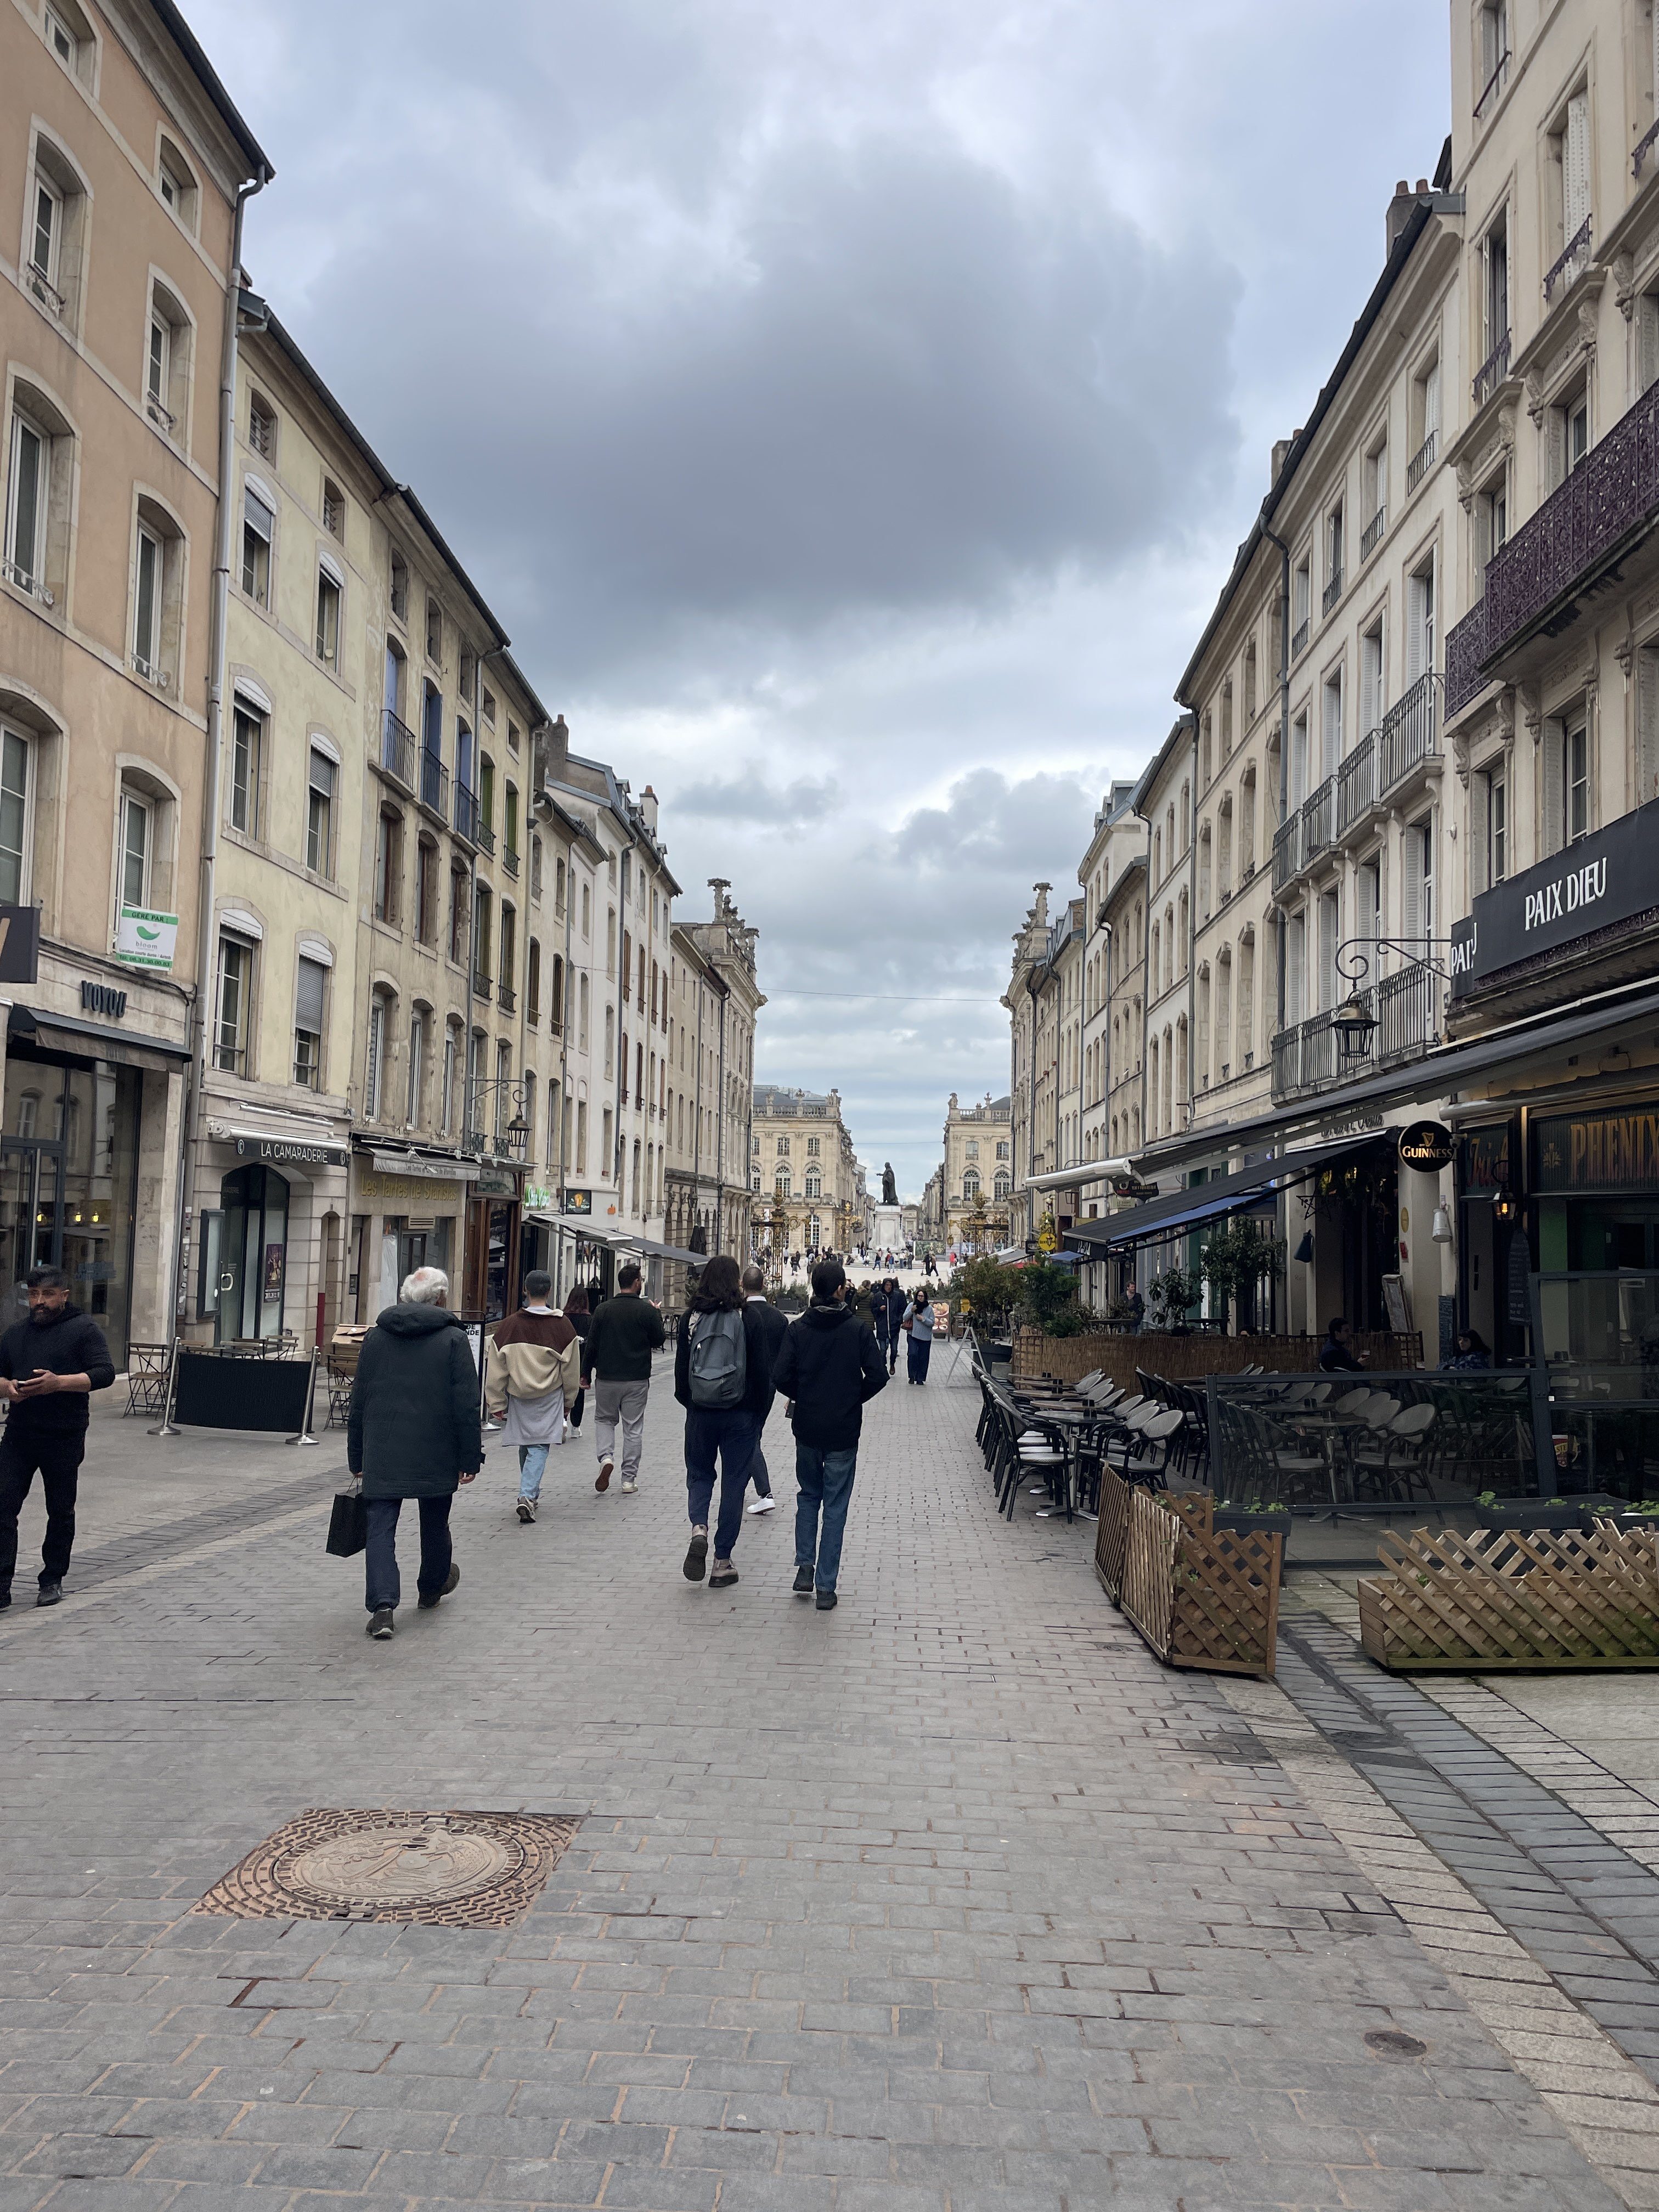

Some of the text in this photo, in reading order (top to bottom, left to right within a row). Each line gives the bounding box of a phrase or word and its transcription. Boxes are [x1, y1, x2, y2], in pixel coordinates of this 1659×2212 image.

[1525, 857, 1607, 931] PAIX DIEU
[132, 912, 149, 920] GÉRÉ
[136, 941, 158, 950] bloom
[81, 980, 128, 1018] VOYOU
[261, 1142, 272, 1158] LA
[274, 1144, 328, 1163] CAMARADERIE
[1402, 1146, 1453, 1158] GUINNESS
[360, 1174, 458, 1201] Les Tartes de Stanislas
